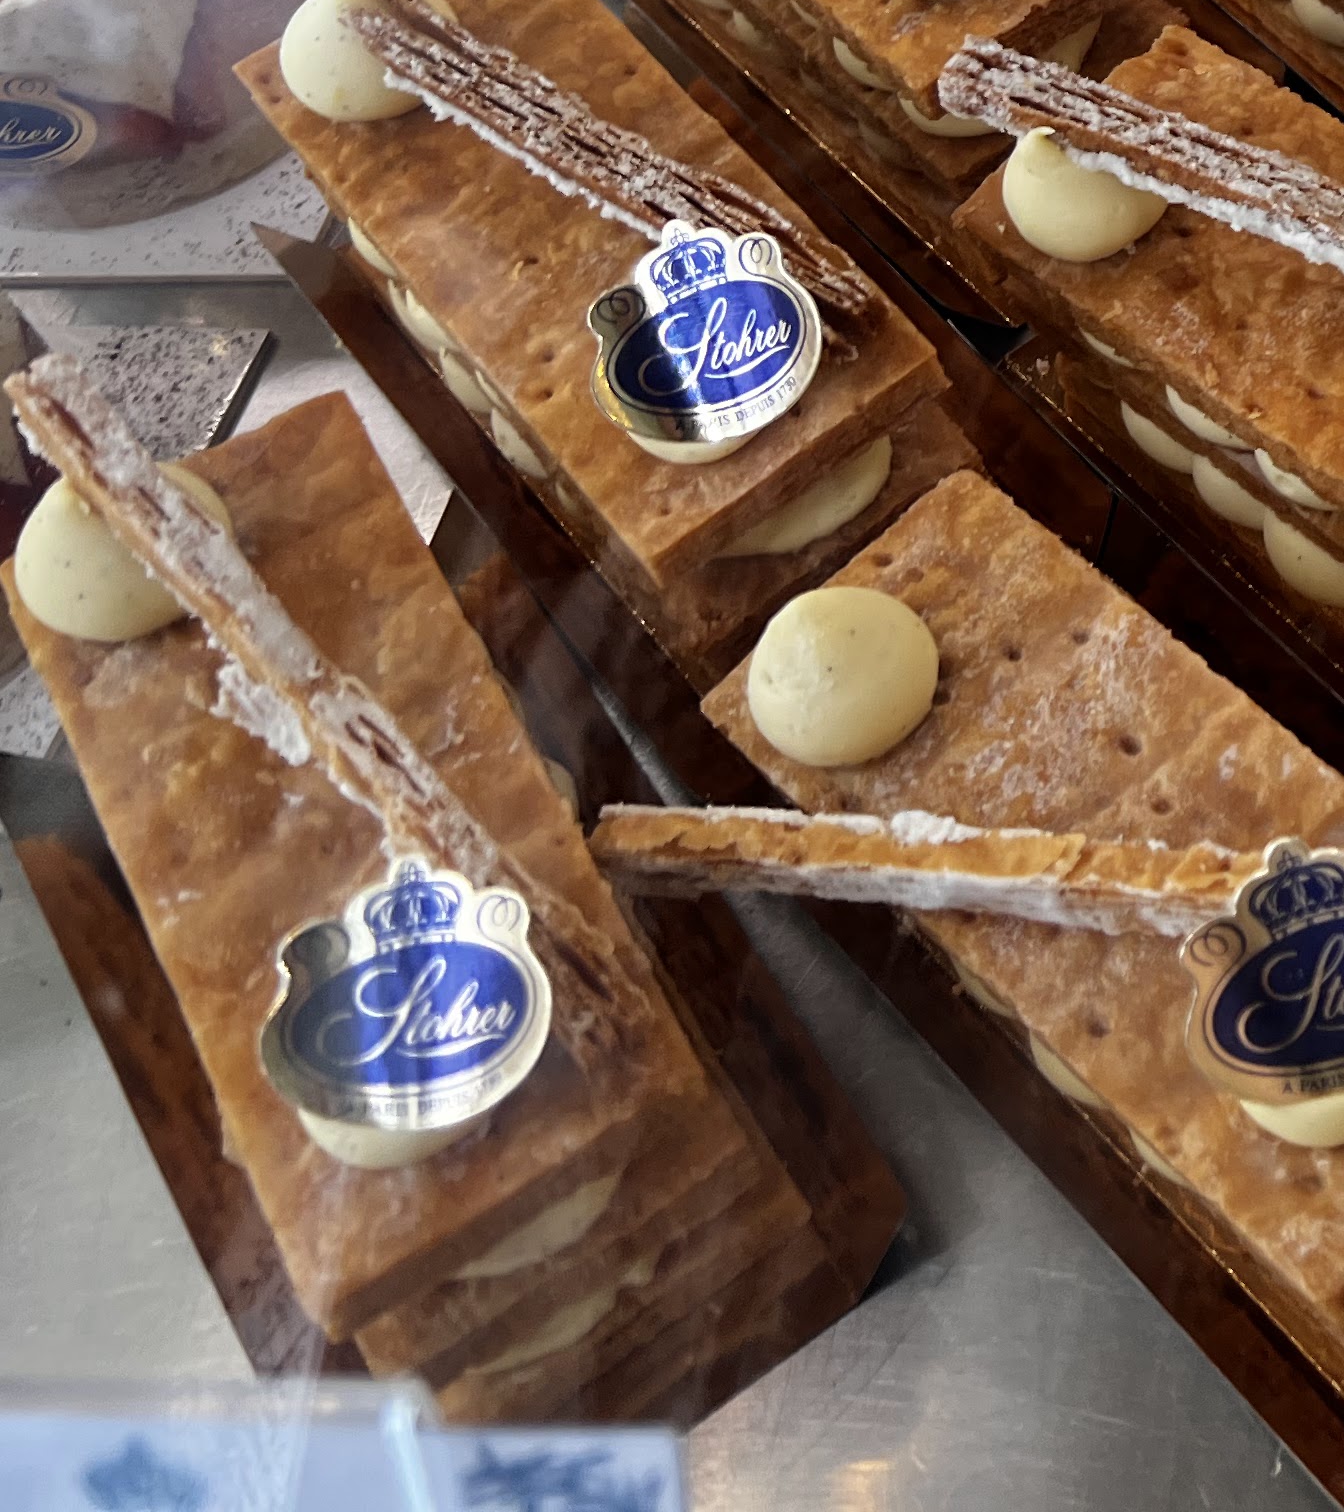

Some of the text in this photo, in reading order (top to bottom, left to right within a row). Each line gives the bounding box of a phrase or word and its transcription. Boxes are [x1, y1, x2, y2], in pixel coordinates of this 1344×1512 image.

[638, 297, 792, 397] Stohrer
[735, 394, 775, 422] DEPUIS
[775, 376, 797, 400] 1730
[316, 955, 517, 1068] Stohrer
